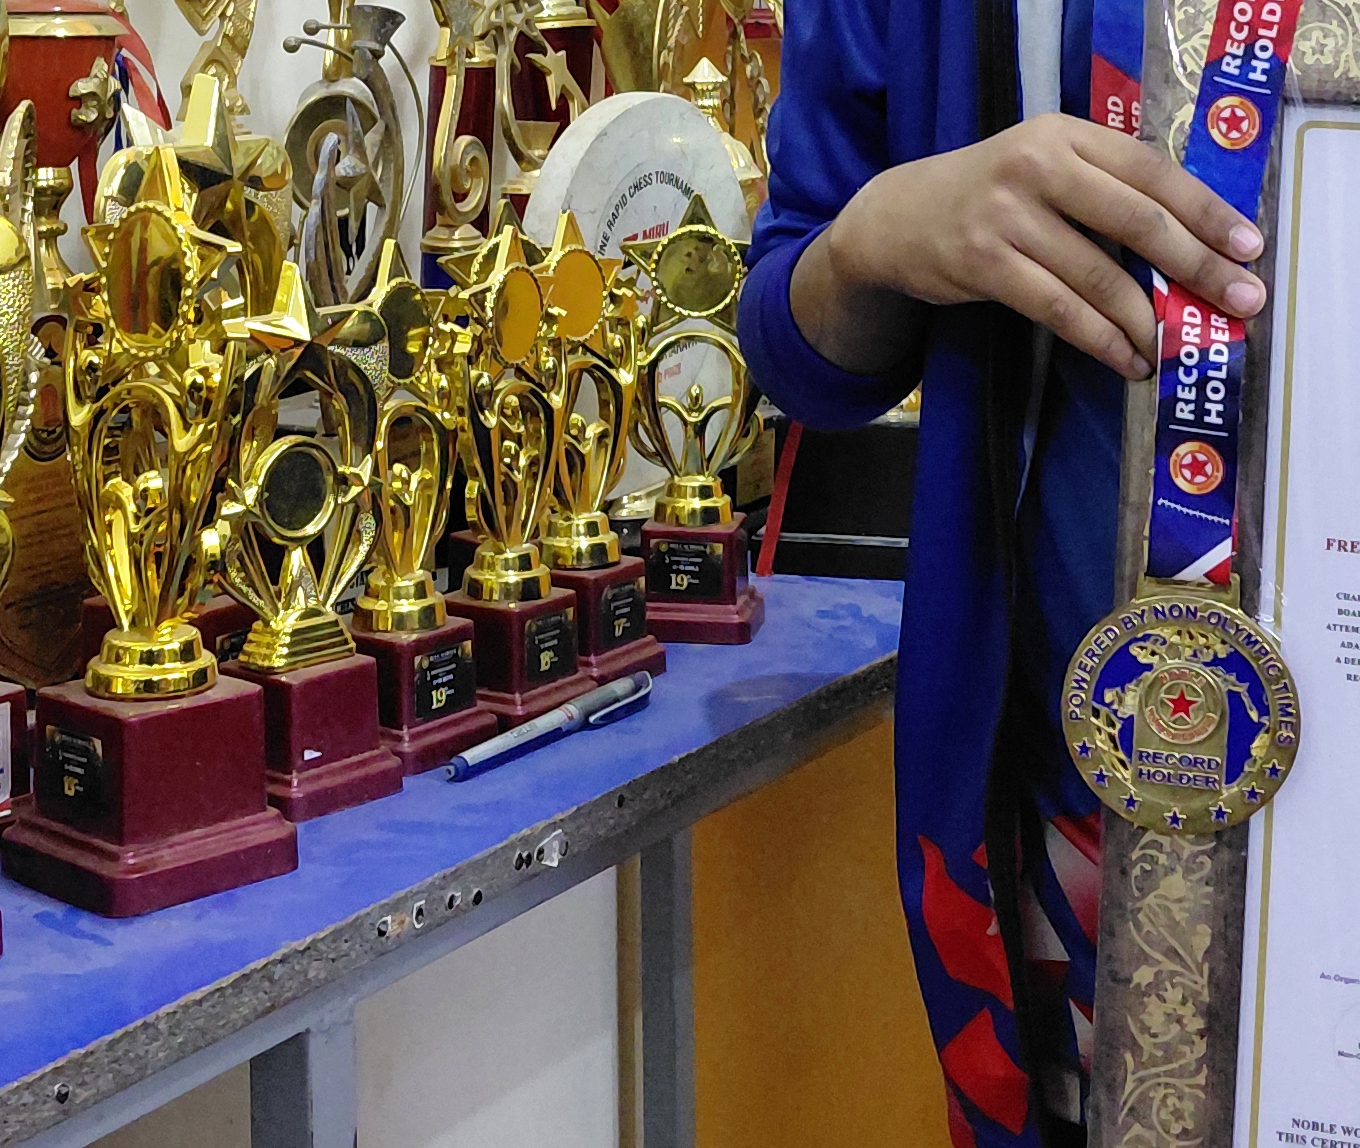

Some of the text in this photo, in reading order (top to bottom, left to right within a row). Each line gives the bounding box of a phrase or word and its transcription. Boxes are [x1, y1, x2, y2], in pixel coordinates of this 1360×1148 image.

[607, 193, 629, 232] RAPID
[628, 172, 653, 199] CHESS
[1175, 305, 1202, 421] RECORD
[1204, 312, 1231, 425] HOLDER
[1068, 627, 1120, 721] POWERED
[1121, 609, 1148, 632] BY
[1154, 604, 1283, 678] NON-OLYMPIC
[1272, 682, 1296, 746] TIMES
[1137, 750, 1221, 771] RECORD
[1137, 769, 1220, 789] HOLDER
[1277, 1131, 1307, 1145] THIS
[1292, 1118, 1337, 1134] NOBLE
